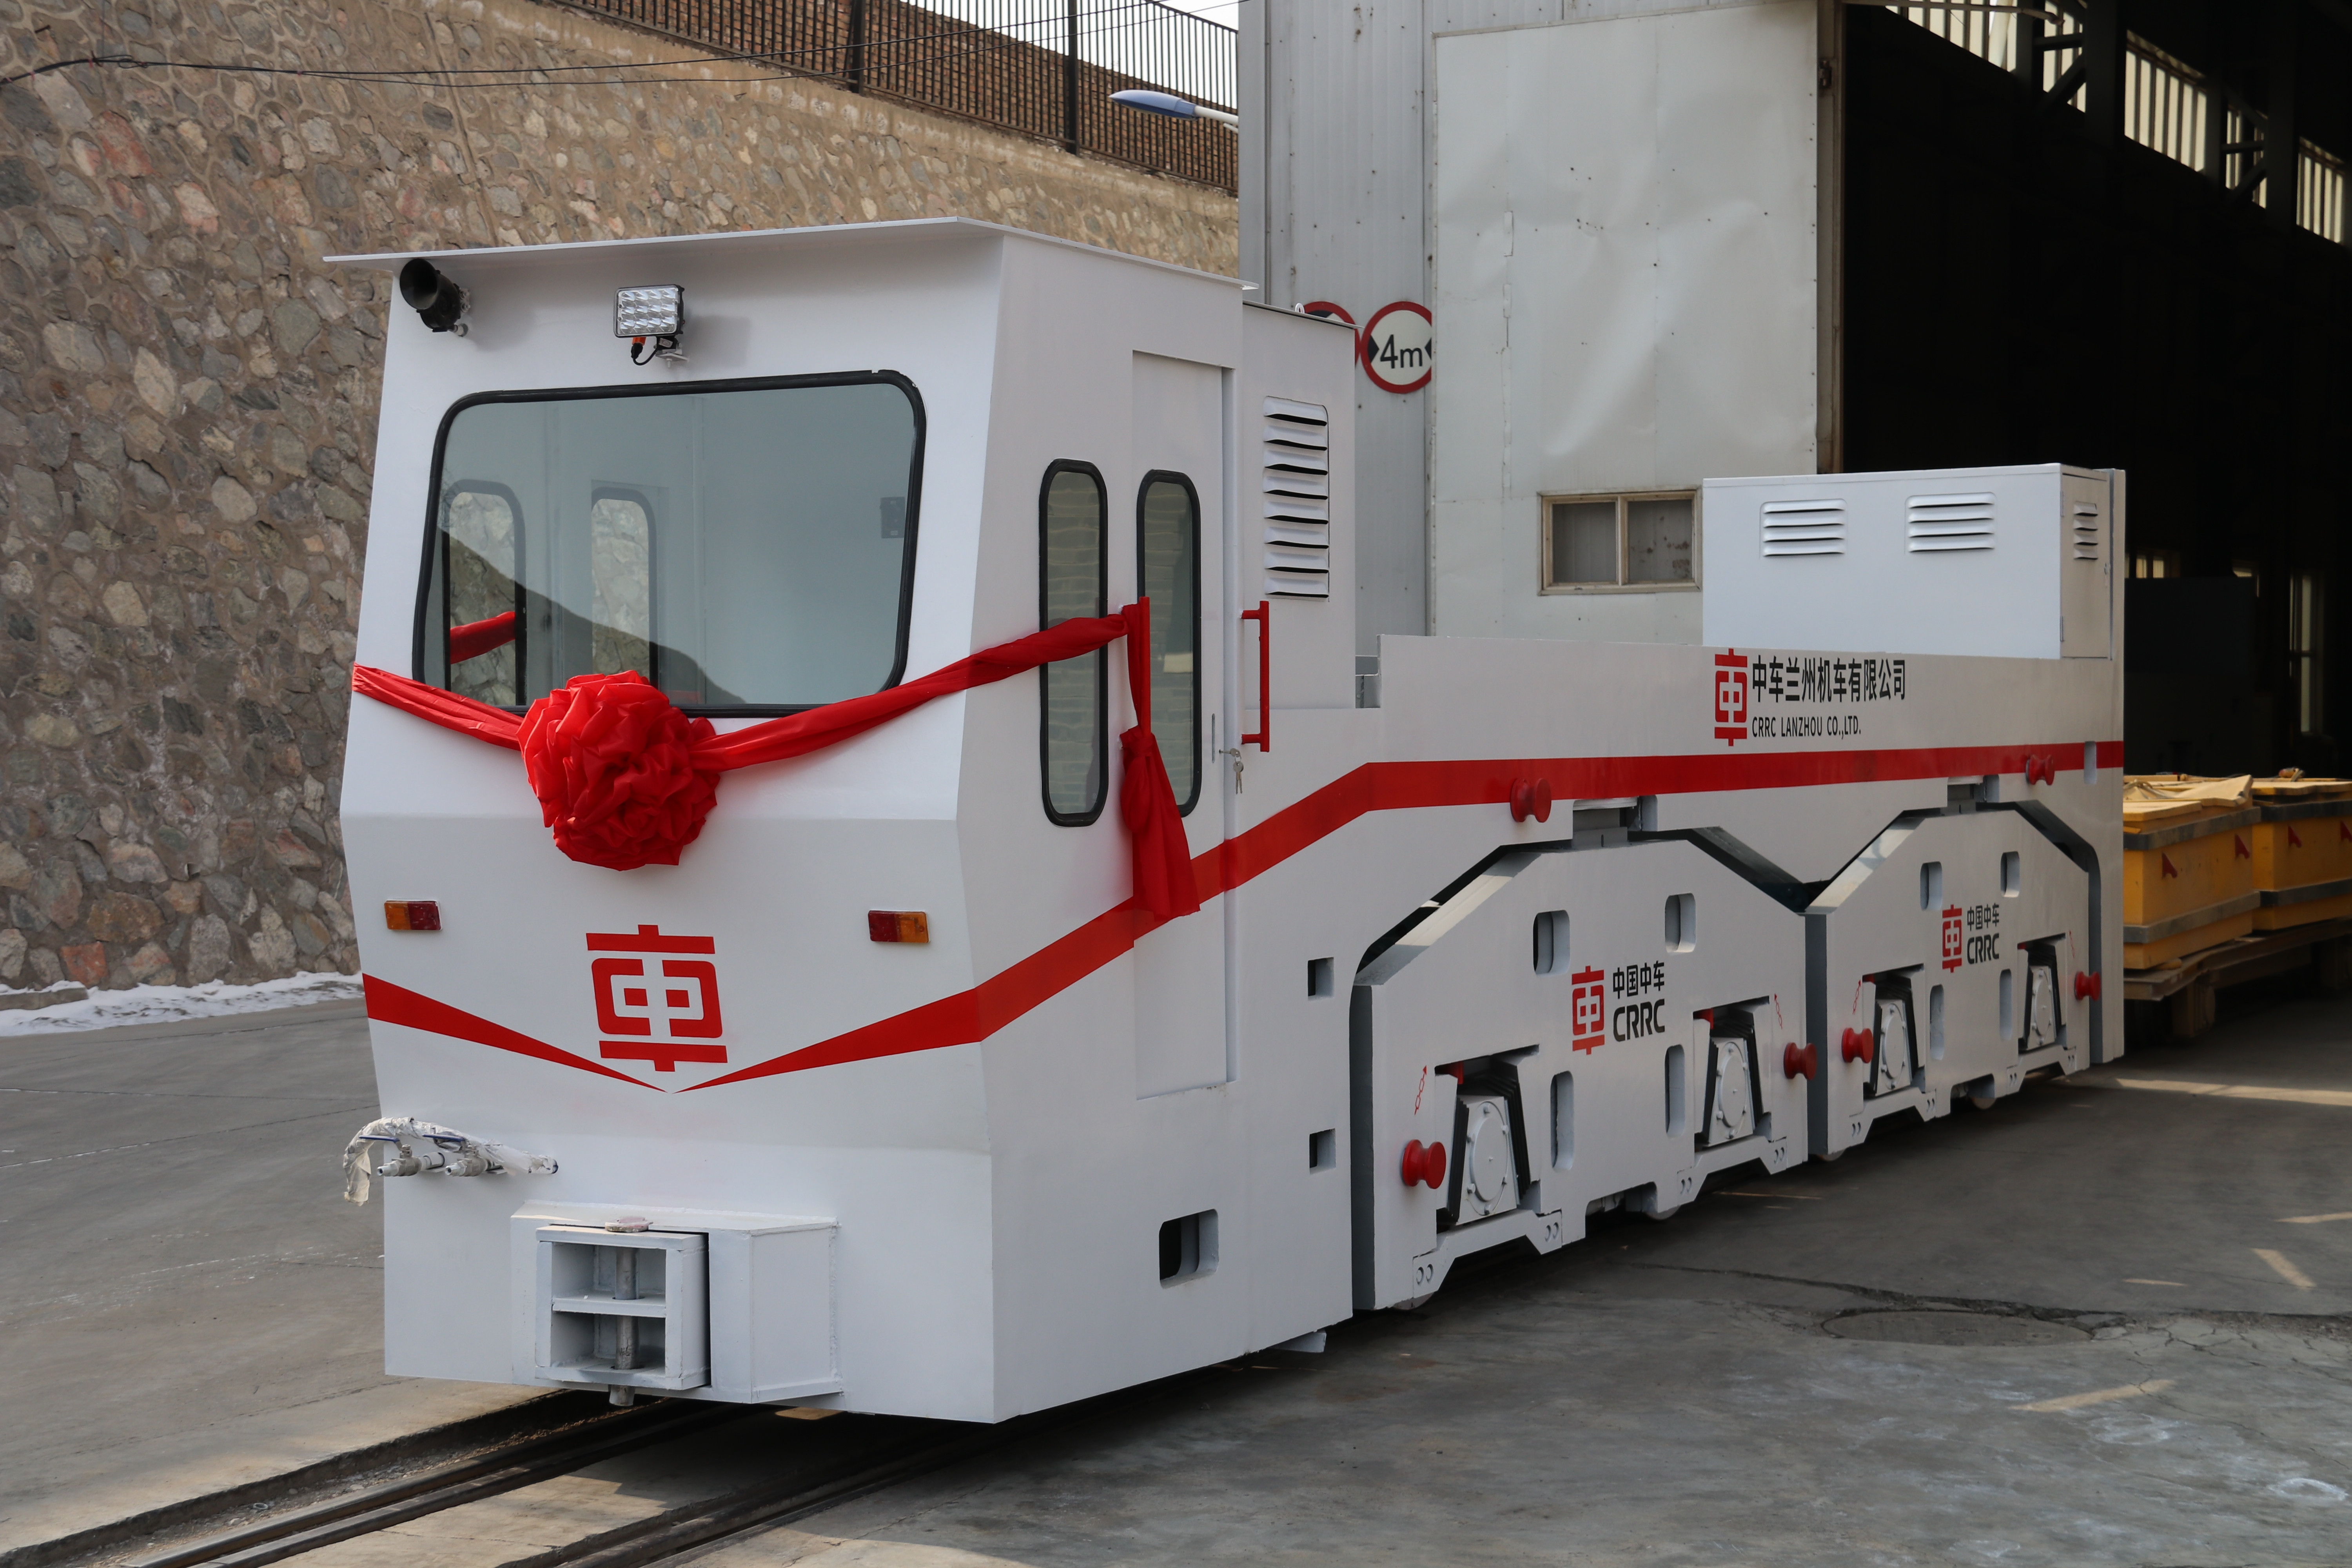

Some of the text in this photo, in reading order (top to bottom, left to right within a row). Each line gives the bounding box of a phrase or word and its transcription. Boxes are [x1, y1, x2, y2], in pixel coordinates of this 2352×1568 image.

[1379, 334, 1423, 369] 4m
[1752, 655, 1906, 703] 中车兰州机车有限公司
[1752, 716, 1776, 737] CRRC
[1781, 716, 1822, 737] LANZHOU
[1967, 903, 2000, 931] 中国中车
[1967, 933, 2000, 965] CRRC
[1613, 960, 1665, 999] 中国中车
[1613, 998, 1665, 1042] CRRC
